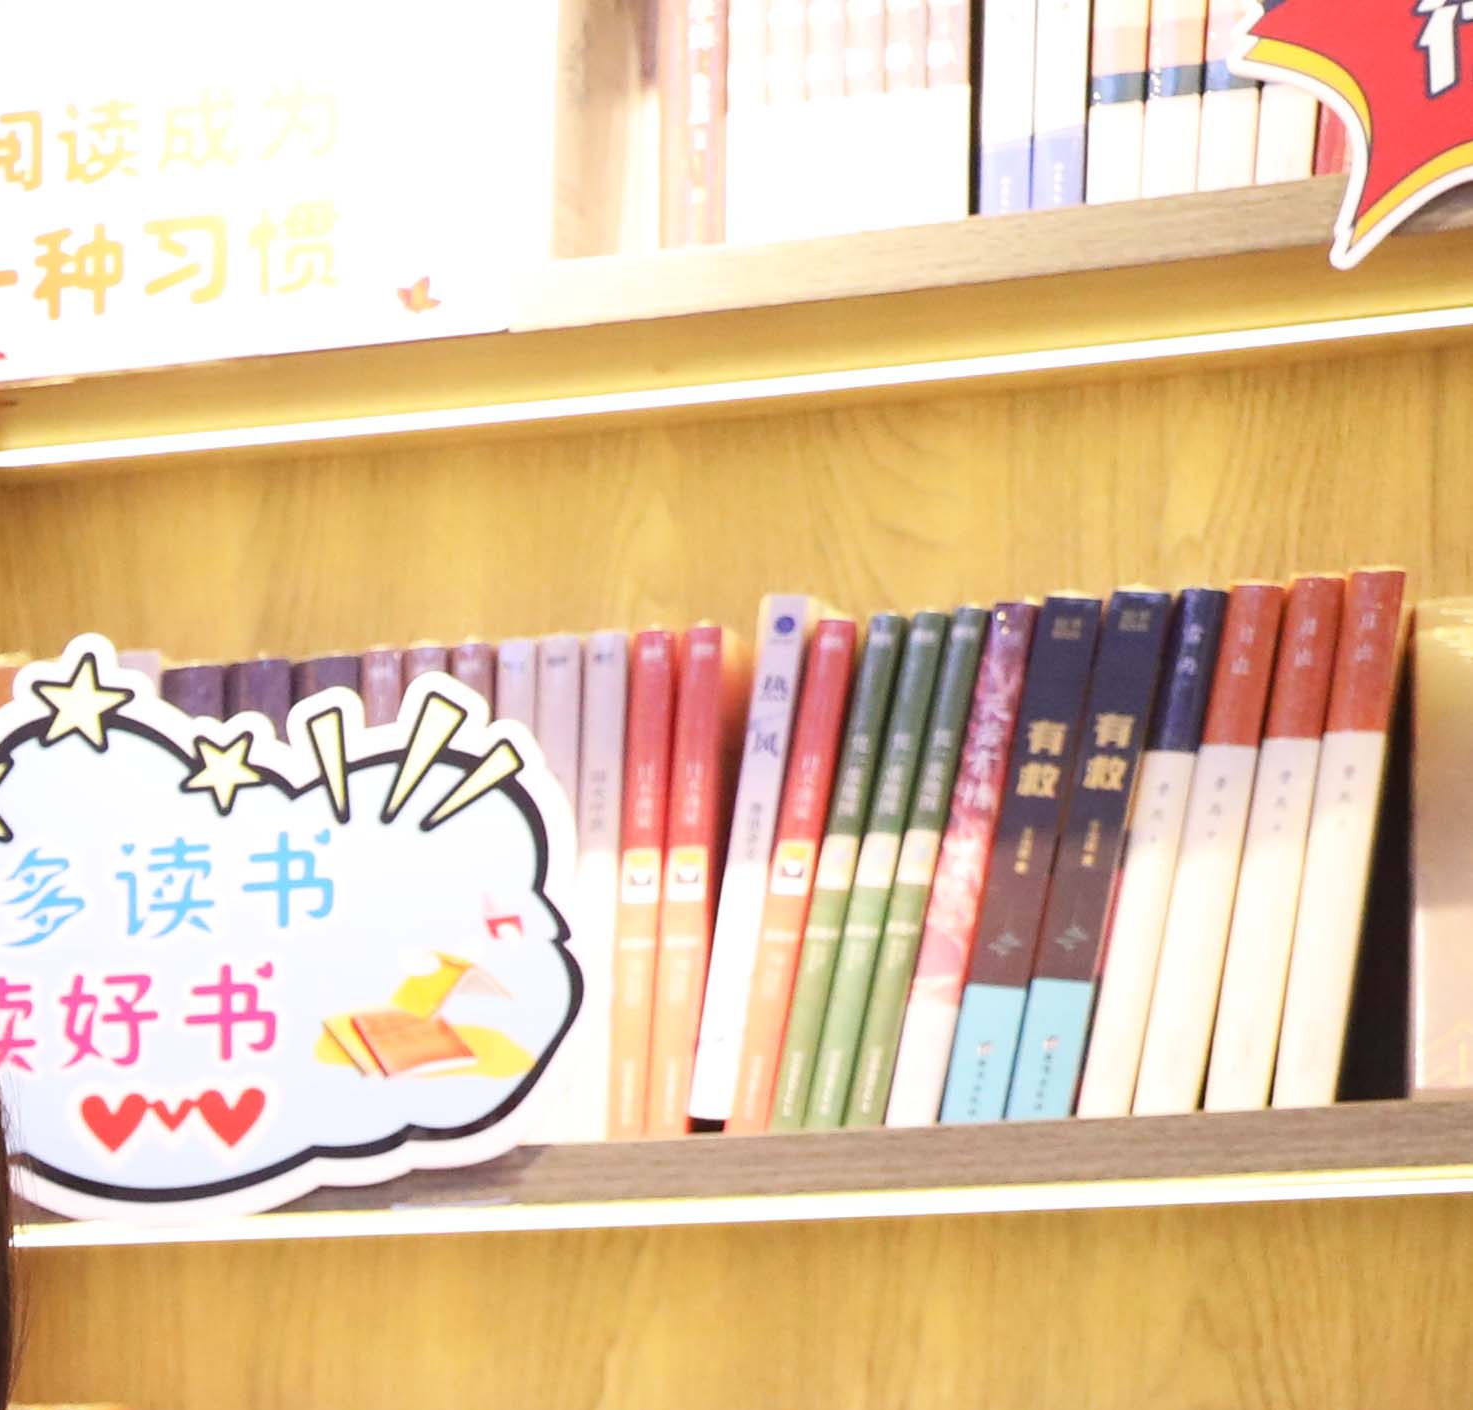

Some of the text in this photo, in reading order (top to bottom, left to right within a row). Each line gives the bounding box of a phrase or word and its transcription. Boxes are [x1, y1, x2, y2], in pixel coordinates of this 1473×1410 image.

[1016, 719, 1068, 799] 有救
[1082, 712, 1135, 791] 有救
[2, 829, 335, 949] 多读书
